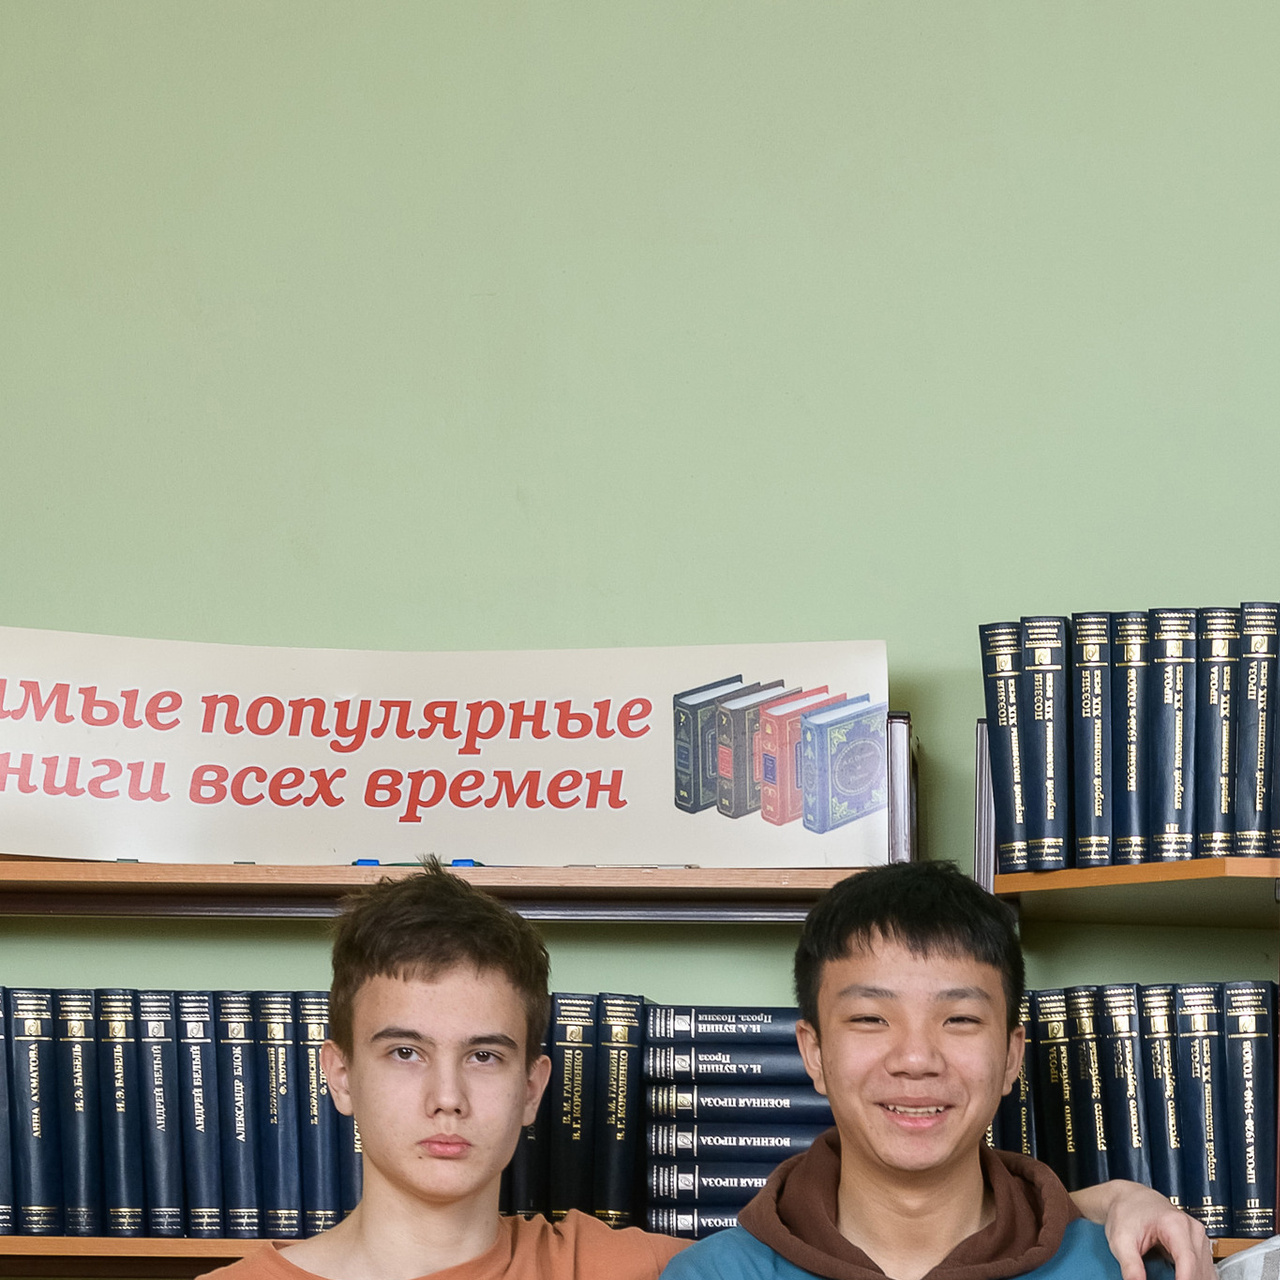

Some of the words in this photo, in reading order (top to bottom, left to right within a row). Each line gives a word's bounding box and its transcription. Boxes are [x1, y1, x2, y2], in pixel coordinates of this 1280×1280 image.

[1248, 660, 1258, 700] ПРОЗА
[0, 677, 182, 731] мые
[201, 693, 652, 755] популярные
[189, 763, 347, 807] всех
[364, 768, 629, 823] времен
[698, 1024, 736, 1033] БУНИН
[28, 1043, 40, 1102] АХМАТОВА
[72, 1043, 83, 1086] БАБЕЛЬ
[151, 1045, 163, 1085] БЕЛЫЙ
[190, 1045, 203, 1085] БЕЛЫЙ
[232, 1046, 243, 1077] БЛОК
[563, 1049, 574, 1097] ГАРШИН
[699, 1064, 736, 1074] БУНИН
[1242, 1040, 1253, 1079] ГОДОВ
[573, 1050, 584, 1117] КОРОЛЕНКО
[700, 1097, 737, 1107] ПРОЗА
[739, 1098, 791, 1108] ВОЕННАЯ
[31, 1107, 42, 1138] АННА
[154, 1087, 166, 1132] АНДРЕЙ
[192, 1087, 205, 1133] АНДРЕЙ
[233, 1079, 246, 1142] АЛЕКСАНДР
[700, 1136, 737, 1146] ПРОЗА
[739, 1137, 791, 1147] ВОЕННАЯ
[702, 1178, 739, 1188] ПРОЗА
[1246, 1145, 1256, 1184] ПРОЗА
